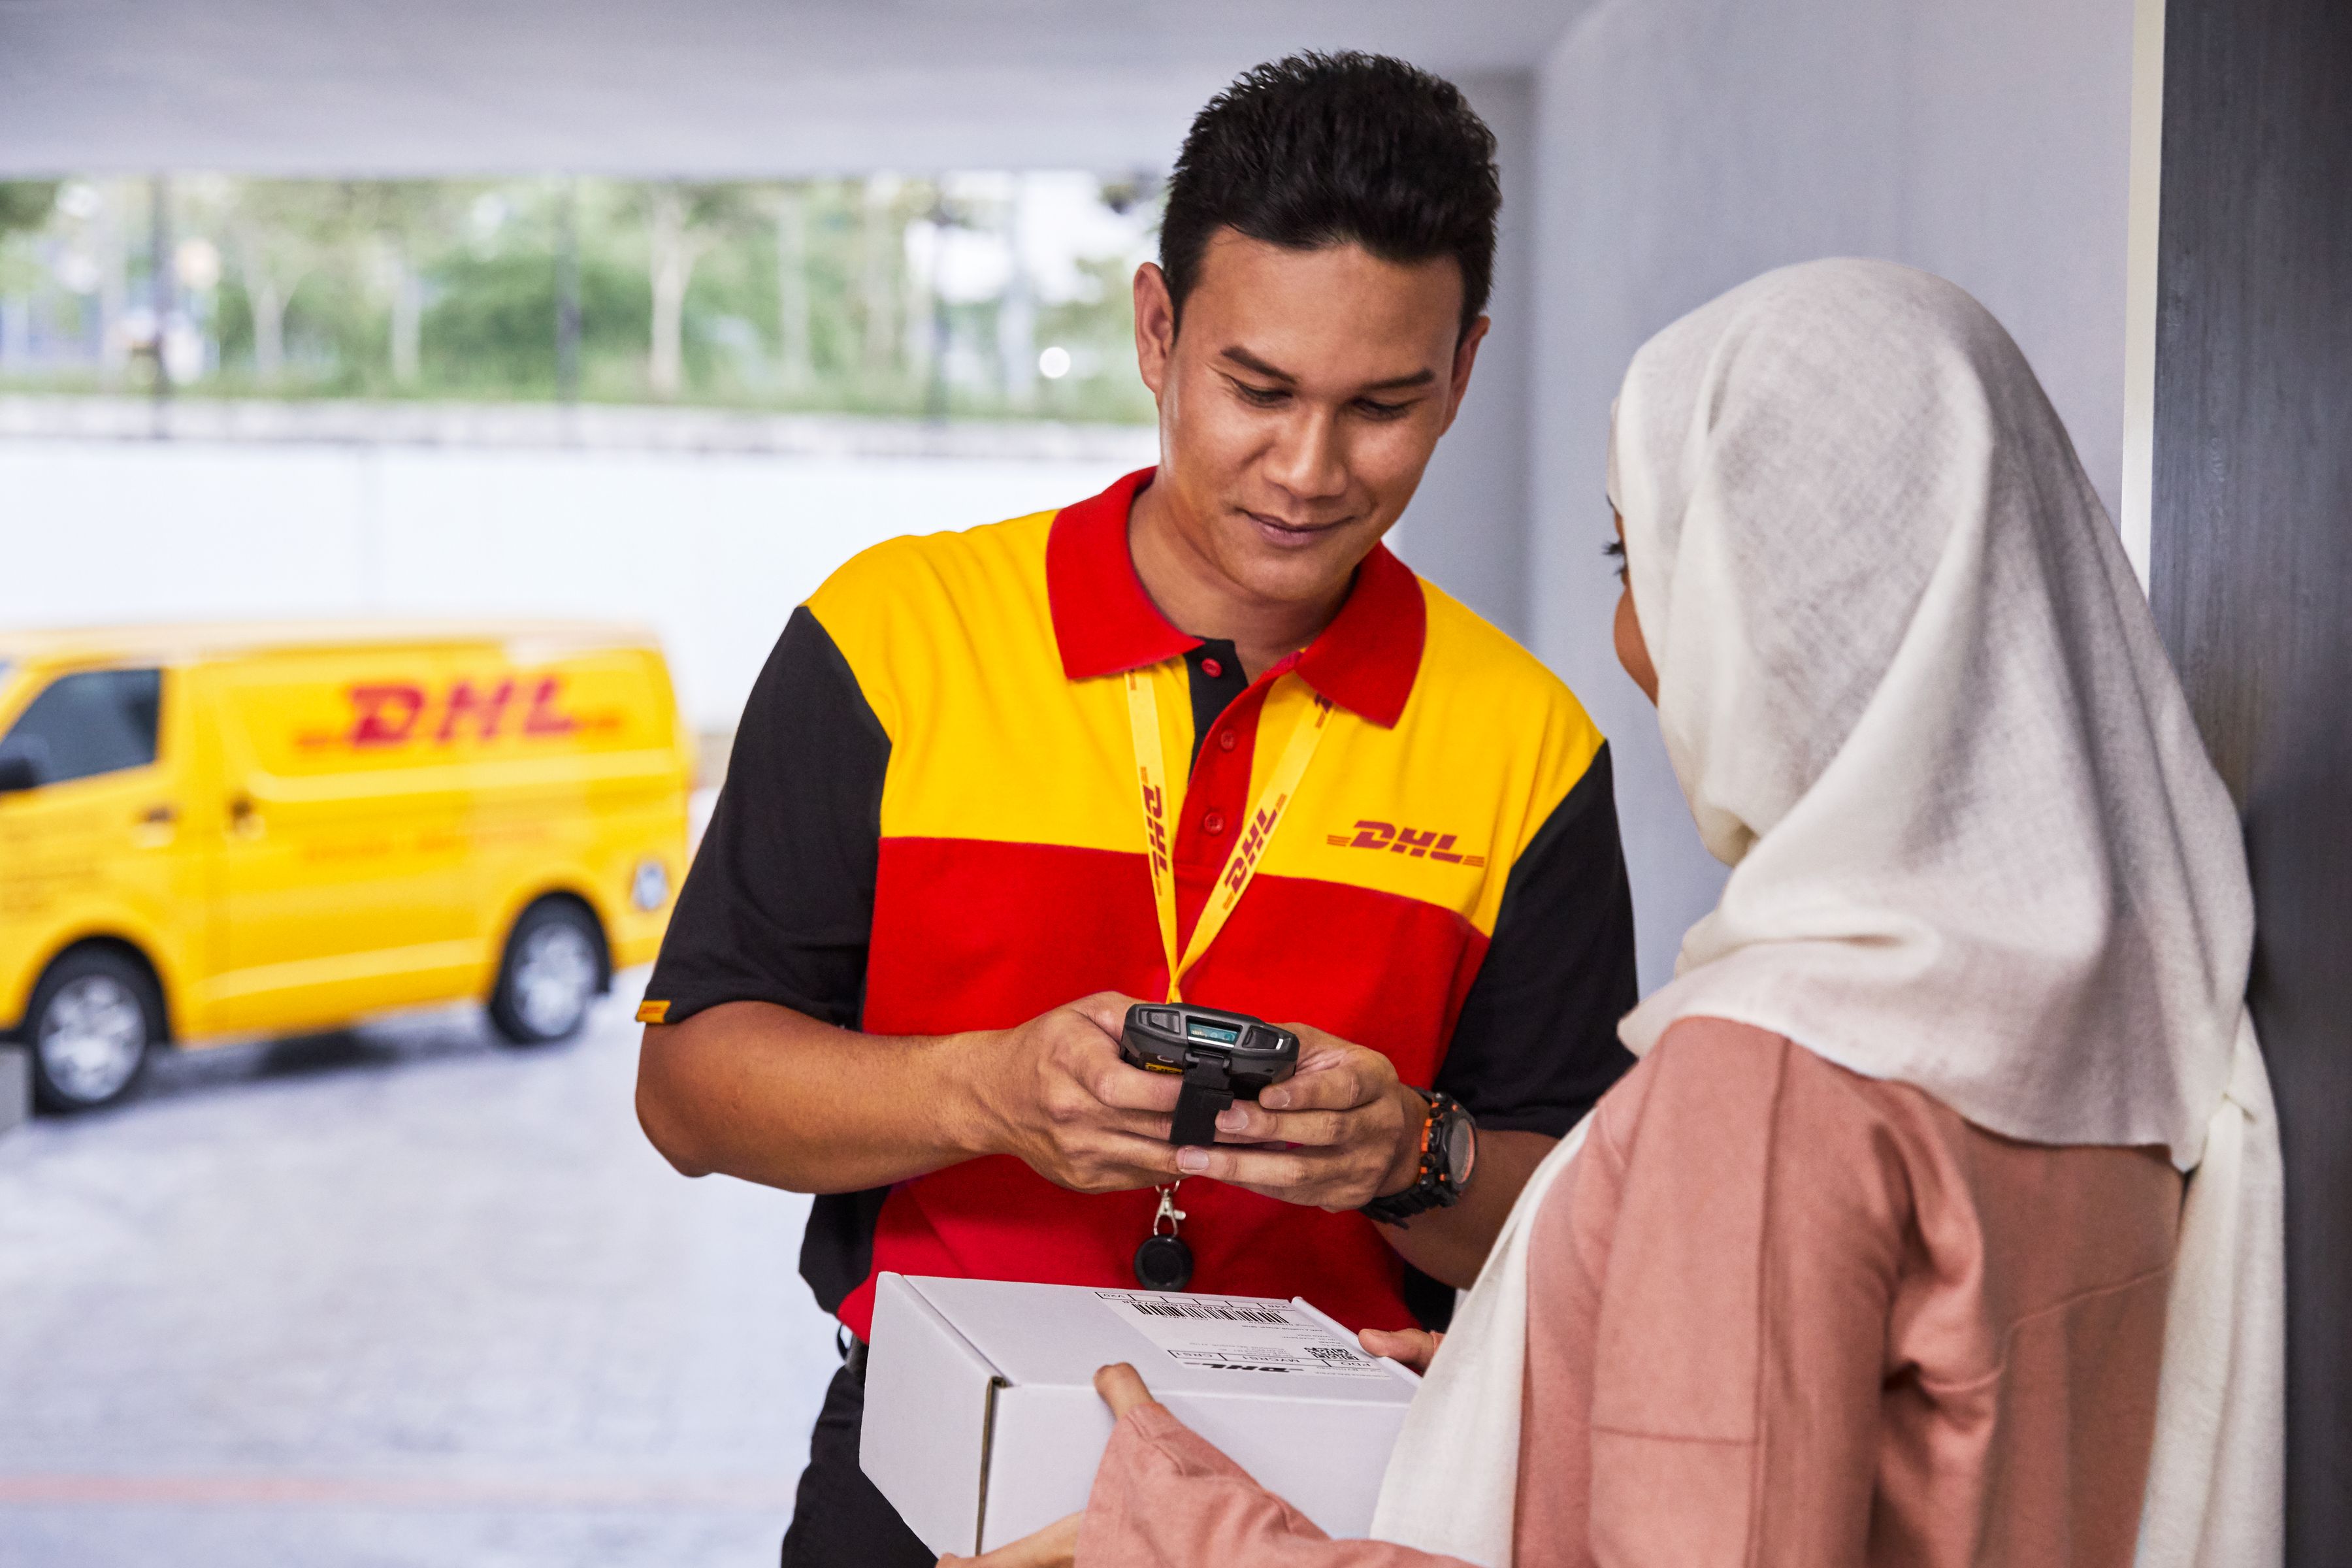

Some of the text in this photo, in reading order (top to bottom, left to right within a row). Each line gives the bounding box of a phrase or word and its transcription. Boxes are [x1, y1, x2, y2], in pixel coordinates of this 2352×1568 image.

[345, 676, 578, 748] DHL
[1143, 785, 1168, 877] DHL
[1223, 808, 1278, 894] DHL
[1350, 820, 1466, 863] DHL
[1201, 1363, 1290, 1373] DHL
